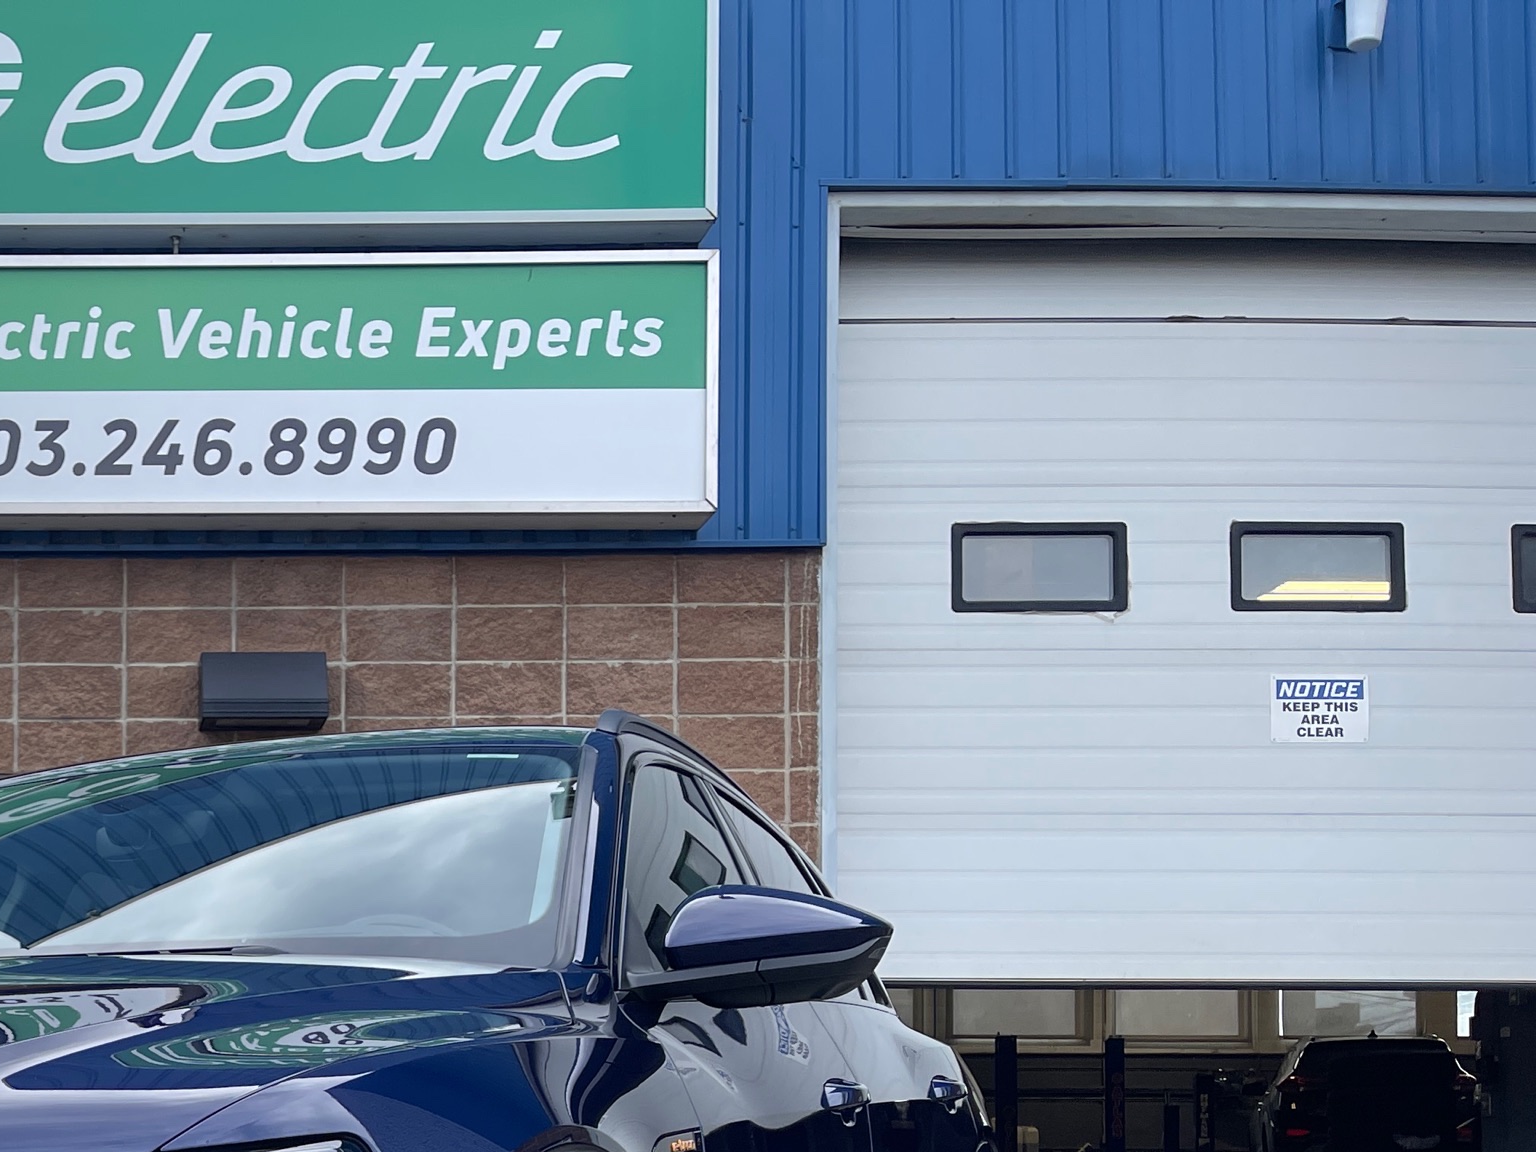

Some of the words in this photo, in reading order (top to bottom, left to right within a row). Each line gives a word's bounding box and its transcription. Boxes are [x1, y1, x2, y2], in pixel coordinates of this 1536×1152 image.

[42, 29, 633, 163] electric
[157, 306, 392, 359] Vehicle
[416, 307, 664, 371] Experts
[1279, 681, 1361, 698] NOTICE
[1282, 702, 1320, 712] KEEP
[1324, 702, 1358, 712] THIS
[1301, 715, 1339, 725] AREA
[1296, 727, 1344, 738] CLEAR
